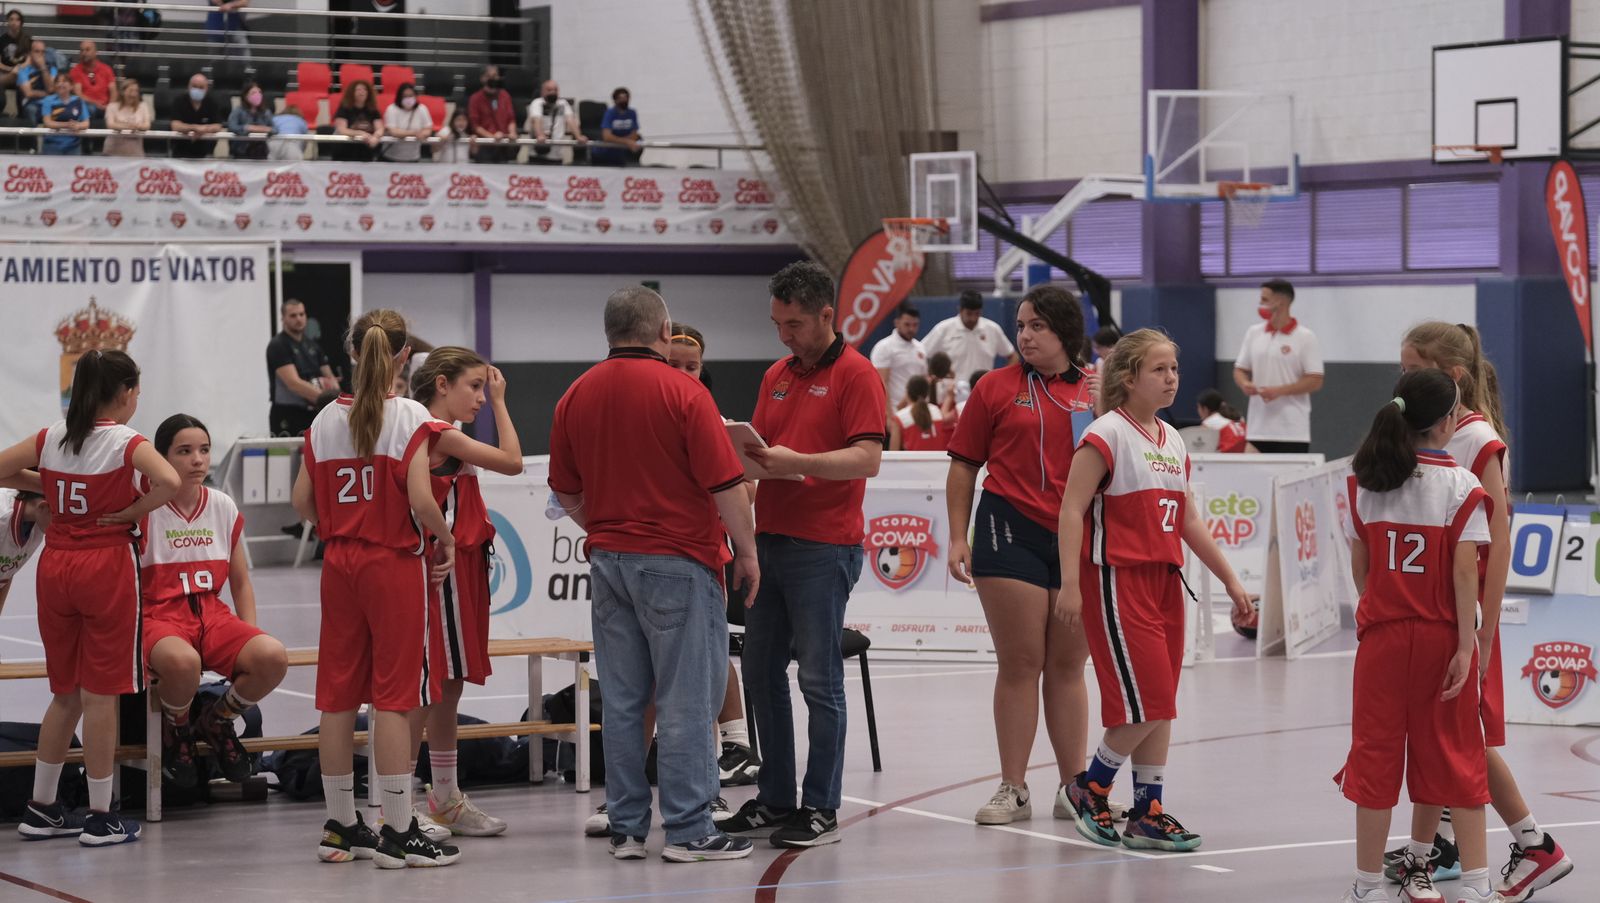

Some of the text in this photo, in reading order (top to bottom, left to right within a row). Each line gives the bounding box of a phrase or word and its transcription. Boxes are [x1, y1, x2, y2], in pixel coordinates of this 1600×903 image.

[8, 164, 48, 179] COPA
[74, 165, 114, 180] COPA
[139, 167, 177, 181] COPA
[204, 170, 239, 183] COPA
[267, 171, 303, 185] COPA
[4, 179, 53, 193] COVAP
[71, 180, 118, 194] COVAP
[136, 181, 182, 196] COVAP
[200, 184, 247, 198] COVAP
[263, 185, 309, 199] COVAP
[1553, 170, 1587, 306] COVAP
[0, 256, 256, 283] AMIENTO DE VIATOR
[336, 465, 375, 503] 20
[56, 479, 89, 515] 15
[881, 517, 918, 527] COPA
[173, 536, 214, 549] COVAP
[871, 530, 928, 547] COVAP
[1386, 529, 1426, 574] 12
[1511, 523, 1554, 577] 0
[1565, 535, 1585, 561] 2
[178, 569, 214, 596] 19
[547, 573, 592, 601] an
[891, 623, 936, 633] DISFRUTA
[955, 624, 990, 634] PARTIC
[1545, 645, 1580, 654] COPA
[1534, 656, 1588, 671] COVAP
